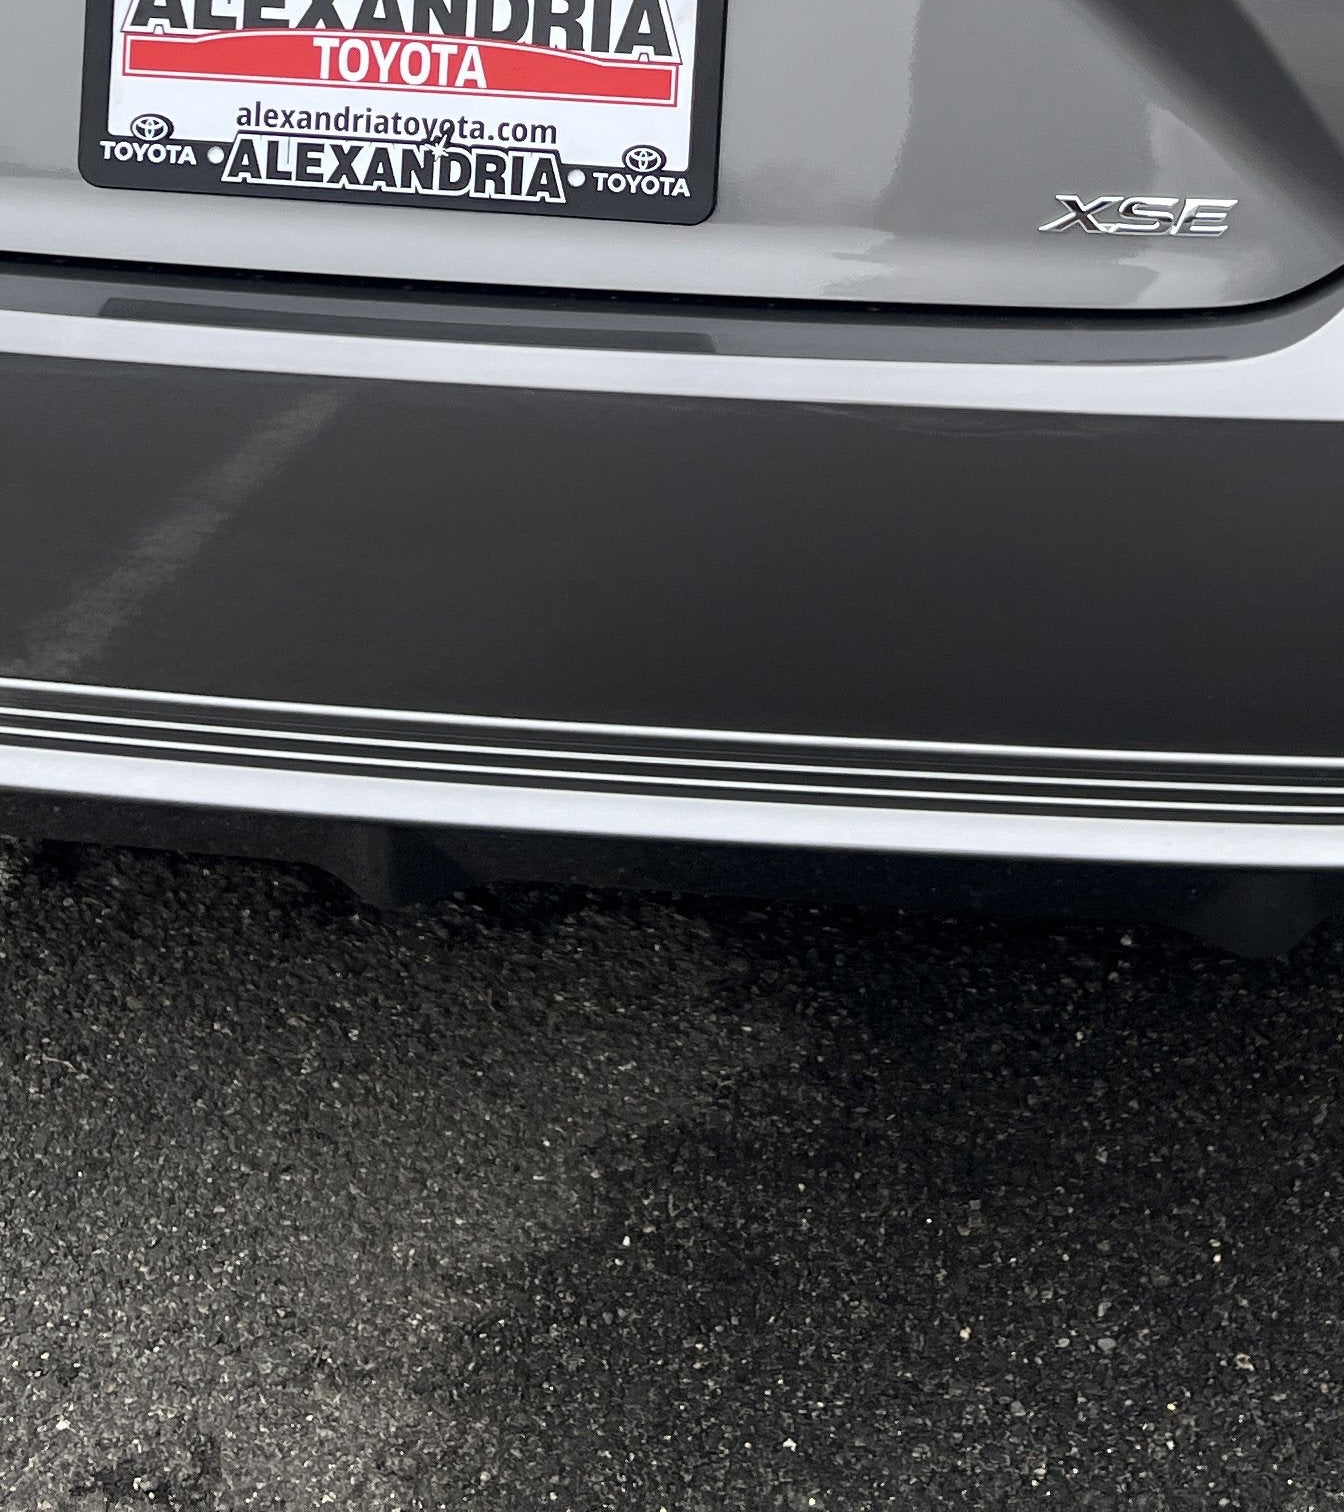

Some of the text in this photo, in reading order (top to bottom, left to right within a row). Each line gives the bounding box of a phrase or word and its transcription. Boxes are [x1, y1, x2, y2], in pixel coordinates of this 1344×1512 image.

[313, 37, 488, 88] TOYOTA
[236, 101, 557, 145] alexandriatoyota.com
[99, 139, 691, 199] TOYOTA ALEXANDRIA TOYOTA
[1038, 194, 1239, 236] XSE
